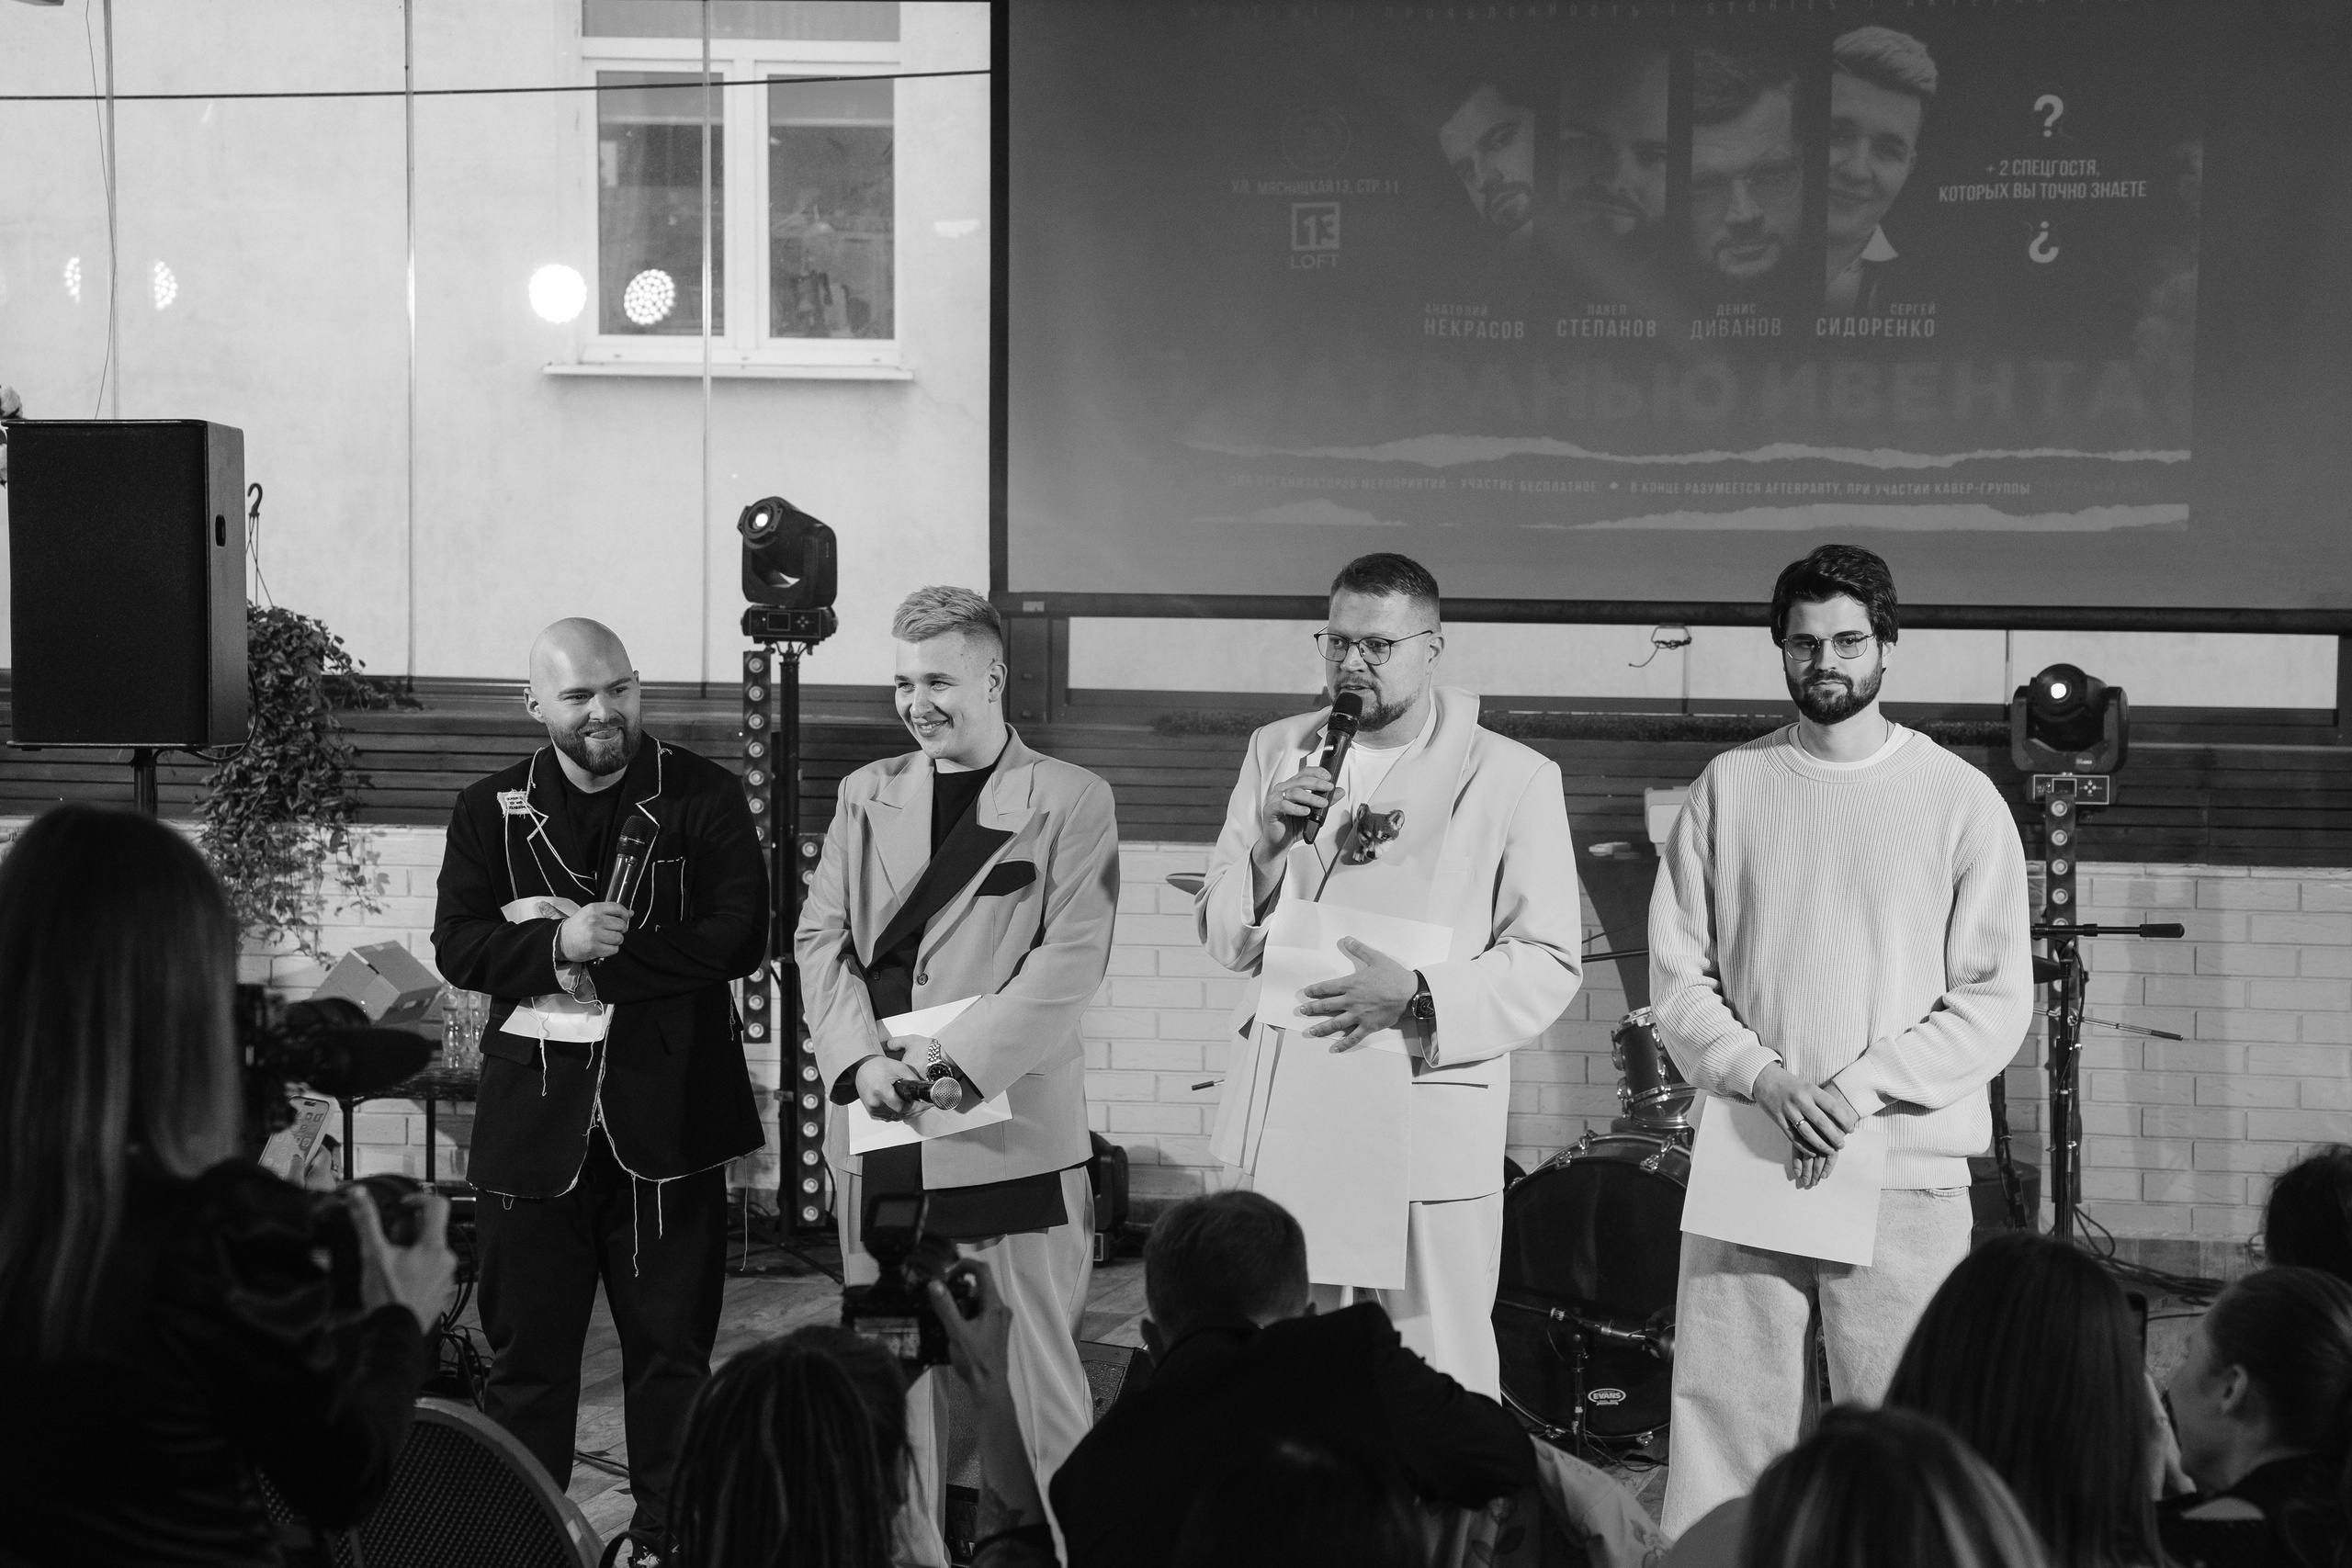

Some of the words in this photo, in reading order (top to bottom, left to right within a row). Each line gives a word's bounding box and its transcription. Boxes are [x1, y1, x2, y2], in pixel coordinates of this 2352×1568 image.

[1998, 159, 2009, 176] 2
[2012, 158, 2100, 178] СПЕЦГОСТЯ,
[1939, 183, 2009, 202] КОТОРЫХ
[2013, 182, 2036, 199] ВЫ
[2041, 182, 2086, 199] ТОЧНО
[2090, 180, 2147, 199] ЗНАЕТЕ
[1290, 254, 1340, 269] LOFT
[1716, 303, 1757, 317] ДЕНИС
[1889, 301, 1936, 315] СЕРГЕЙ
[1424, 318, 1524, 339] НЕКРАСОВ
[1556, 319, 1657, 338] СТЕПАНОВ
[1690, 318, 1781, 340] ДИВАНОВ
[1815, 317, 1935, 337] СИДОРЕНКО
[1684, 482, 1760, 494] РАЗУМЕЕТСЯ
[1847, 482, 1871, 494] ПРИ
[1875, 482, 1929, 495] УЧАСТИИ
[1934, 482, 2030, 495] КАВЕР-ГРУППЫ
